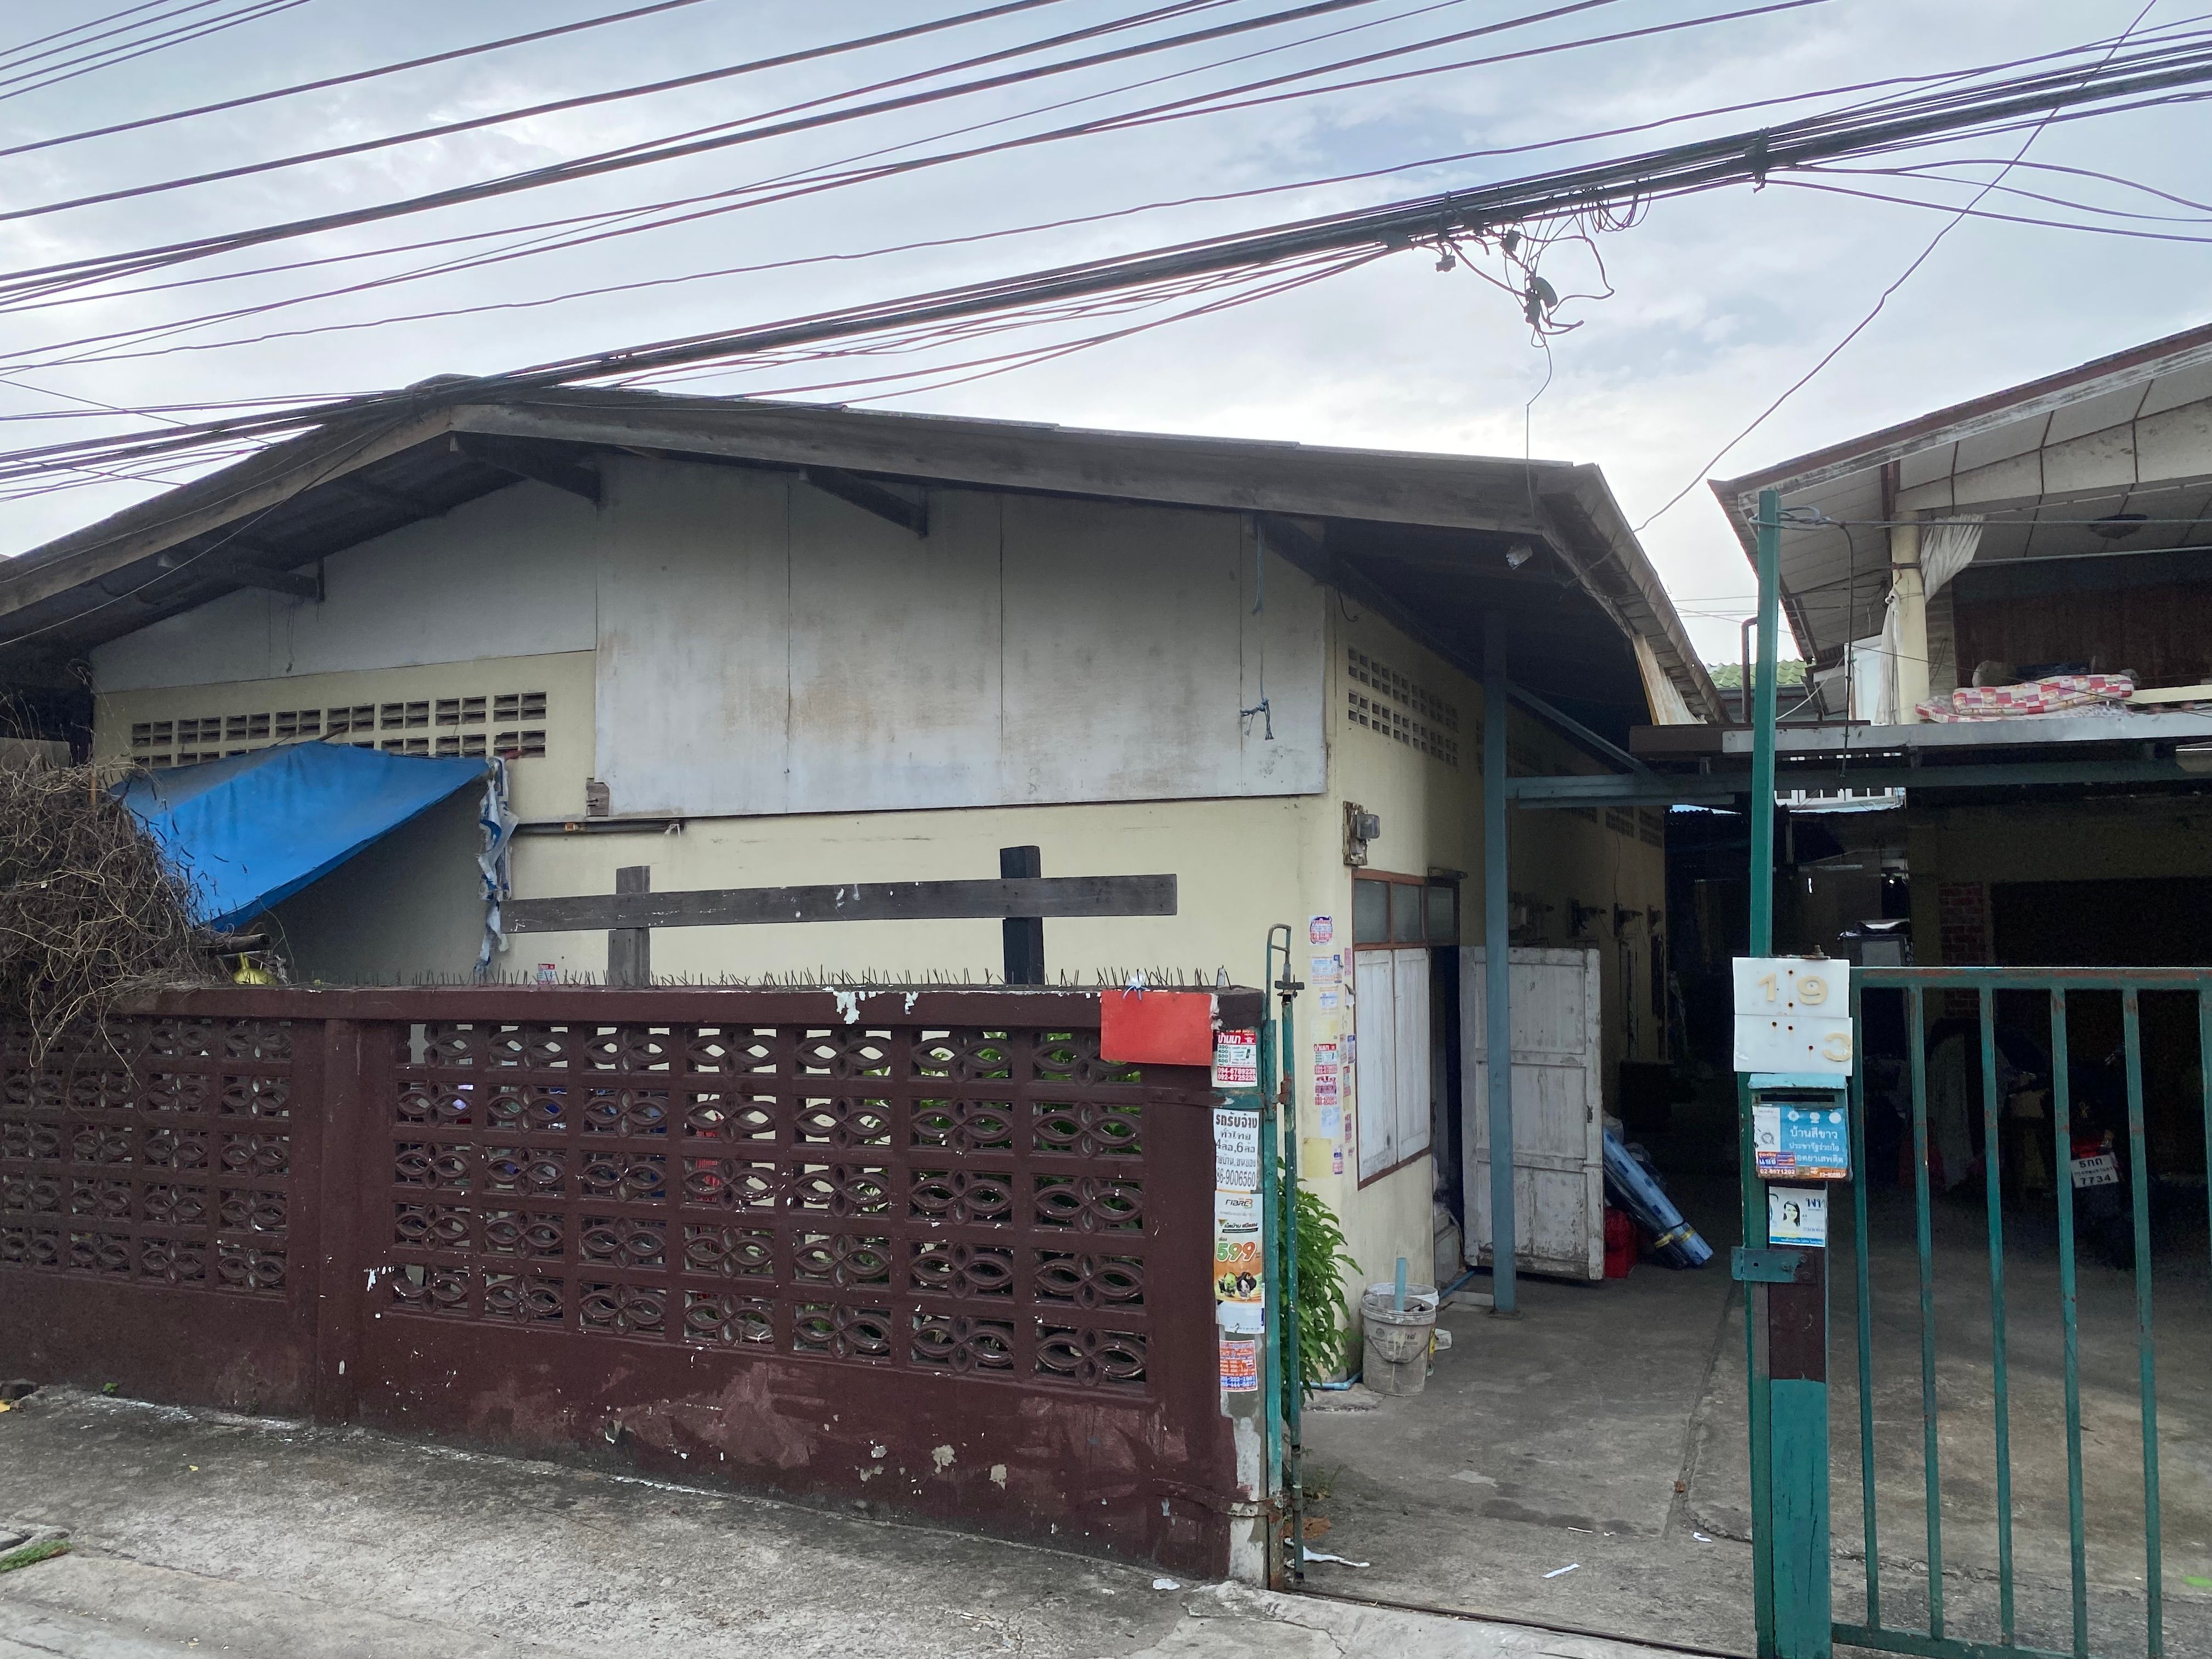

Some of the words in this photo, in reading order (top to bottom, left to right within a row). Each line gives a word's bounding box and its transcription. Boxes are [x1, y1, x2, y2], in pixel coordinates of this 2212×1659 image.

[1221, 1127, 1251, 1140] ทั่วไทย
[1790, 1125, 1838, 1139] บ้านสีขาว
[2080, 1173, 2111, 1185] 7734
[1217, 1242, 1256, 1261] 599
